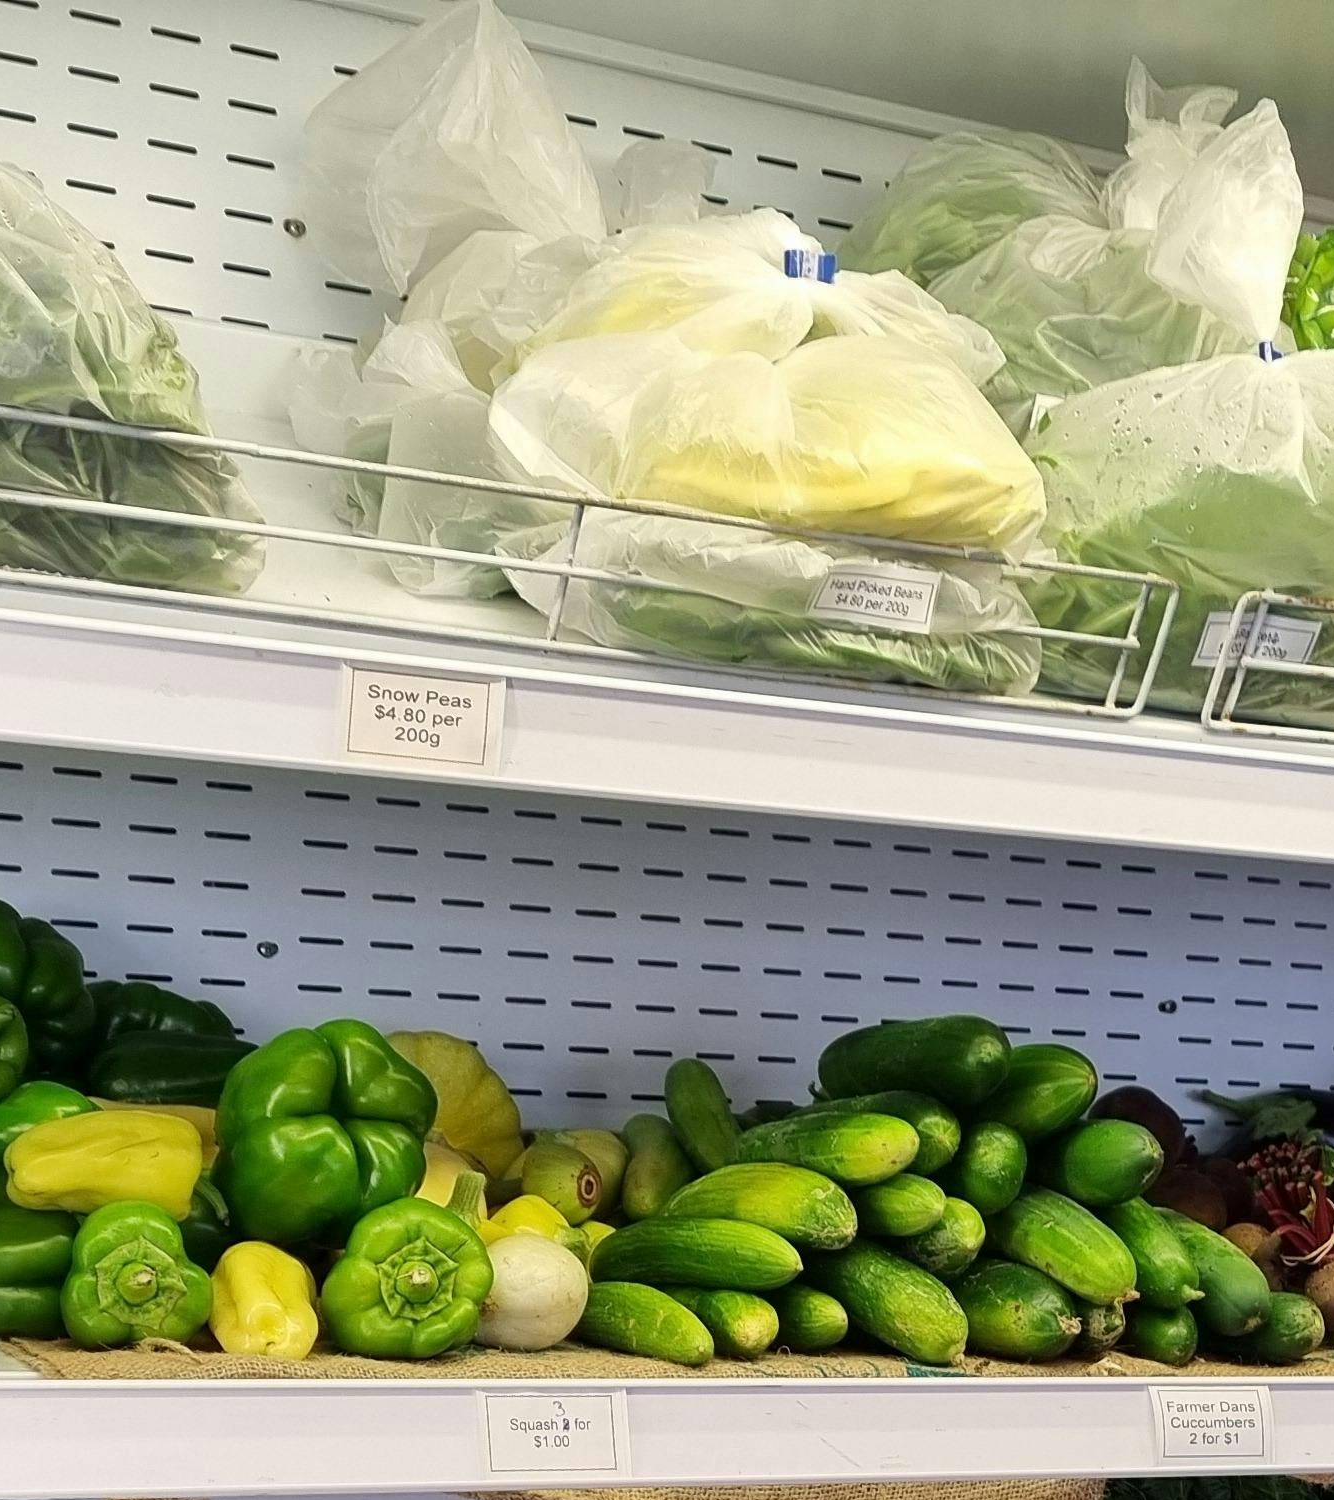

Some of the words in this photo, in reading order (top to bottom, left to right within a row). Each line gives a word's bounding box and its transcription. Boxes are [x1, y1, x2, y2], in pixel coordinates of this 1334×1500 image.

[830, 579, 856, 591] Hand
[857, 580, 892, 596] Picked
[894, 586, 923, 600] Beans
[866, 597, 883, 610] per
[885, 601, 909, 616] 200g
[368, 684, 419, 703] Snow
[426, 690, 472, 709] Peas
[374, 704, 426, 724] $4.80
[432, 713, 463, 728] per
[395, 726, 440, 747] 200g
[1167, 1401, 1215, 1413] Farmer
[1220, 1401, 1255, 1413] Dans
[509, 1418, 558, 1433] Squash
[575, 1418, 591, 1431] for
[1170, 1417, 1255, 1428] Cuccumbers
[533, 1435, 570, 1448] $1.00
[1189, 1433, 1198, 1444] 2
[1202, 1433, 1219, 1444] for
[1224, 1432, 1239, 1445] $1
